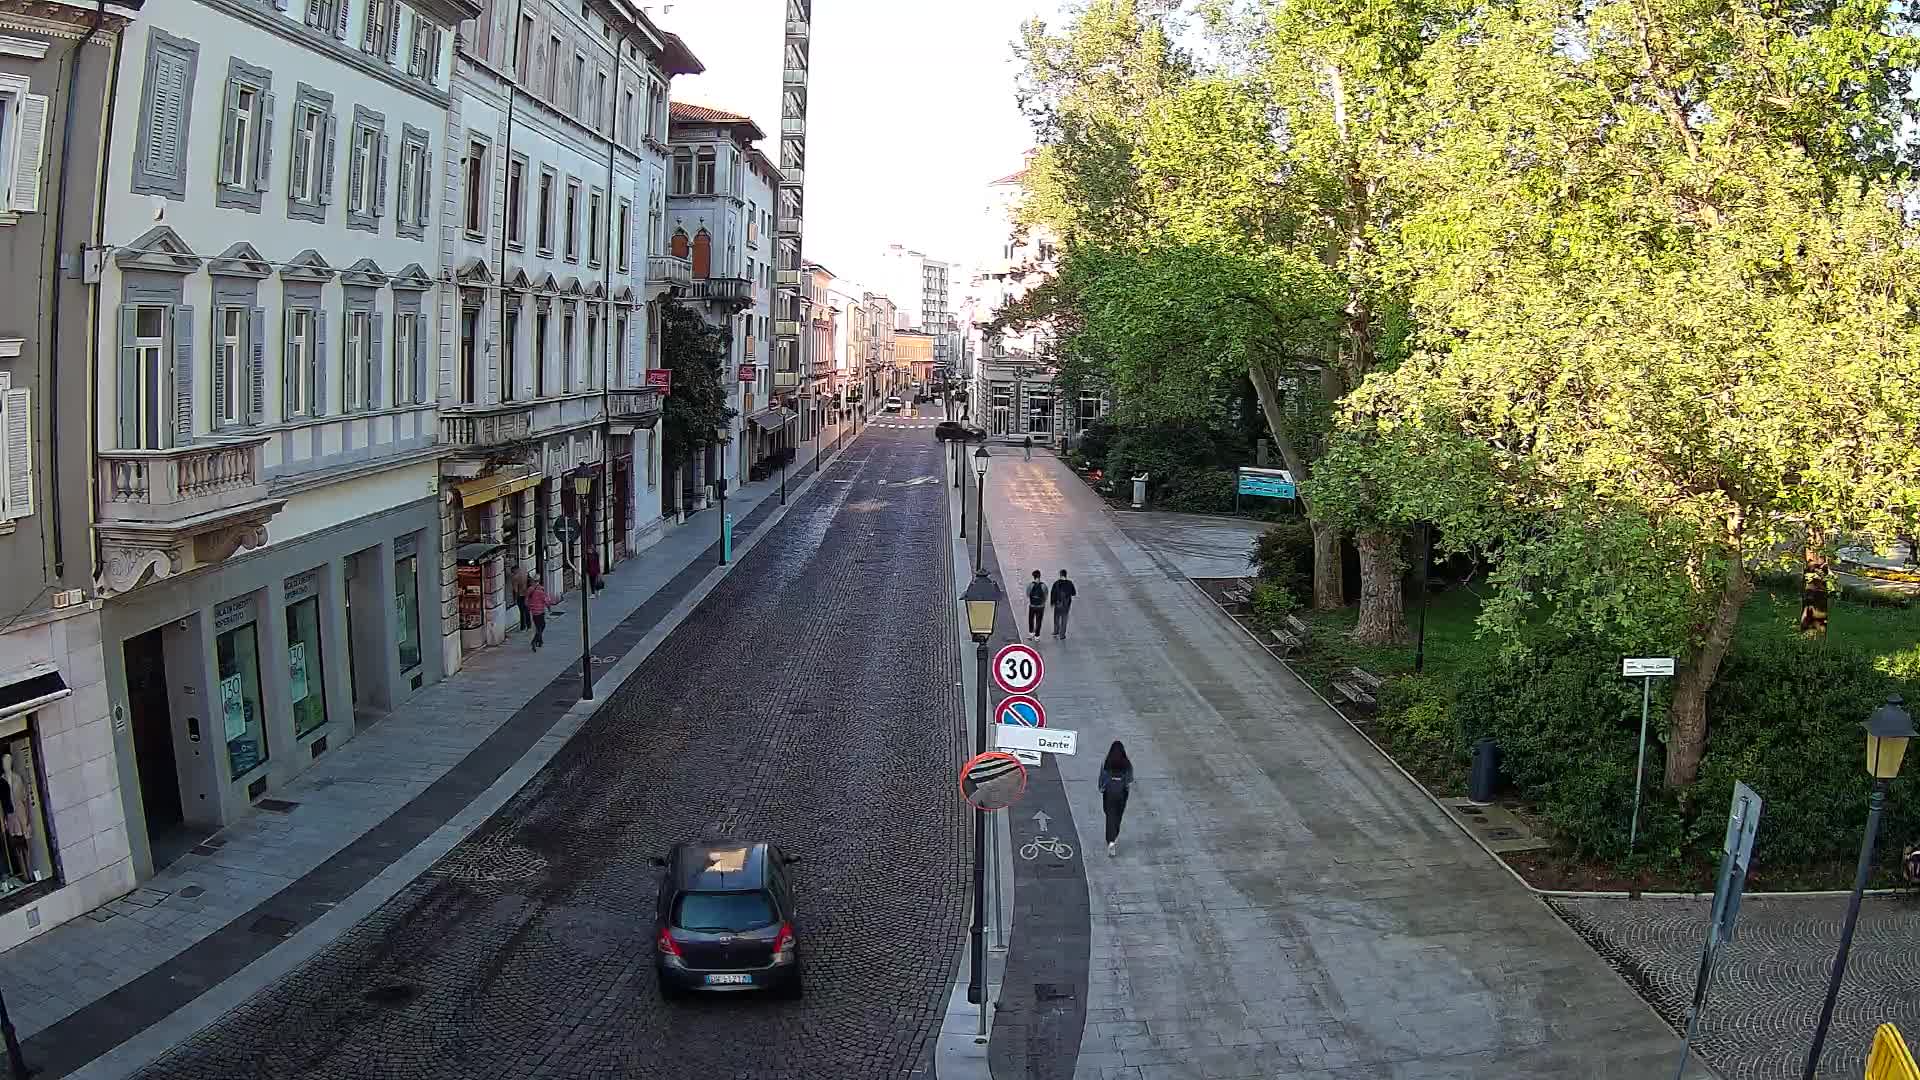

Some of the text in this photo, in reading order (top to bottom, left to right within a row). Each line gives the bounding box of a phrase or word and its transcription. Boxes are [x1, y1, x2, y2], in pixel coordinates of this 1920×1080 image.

[1005, 658, 1033, 680] 30
[222, 678, 240, 701] 130
[1038, 738, 1070, 749] Dante
